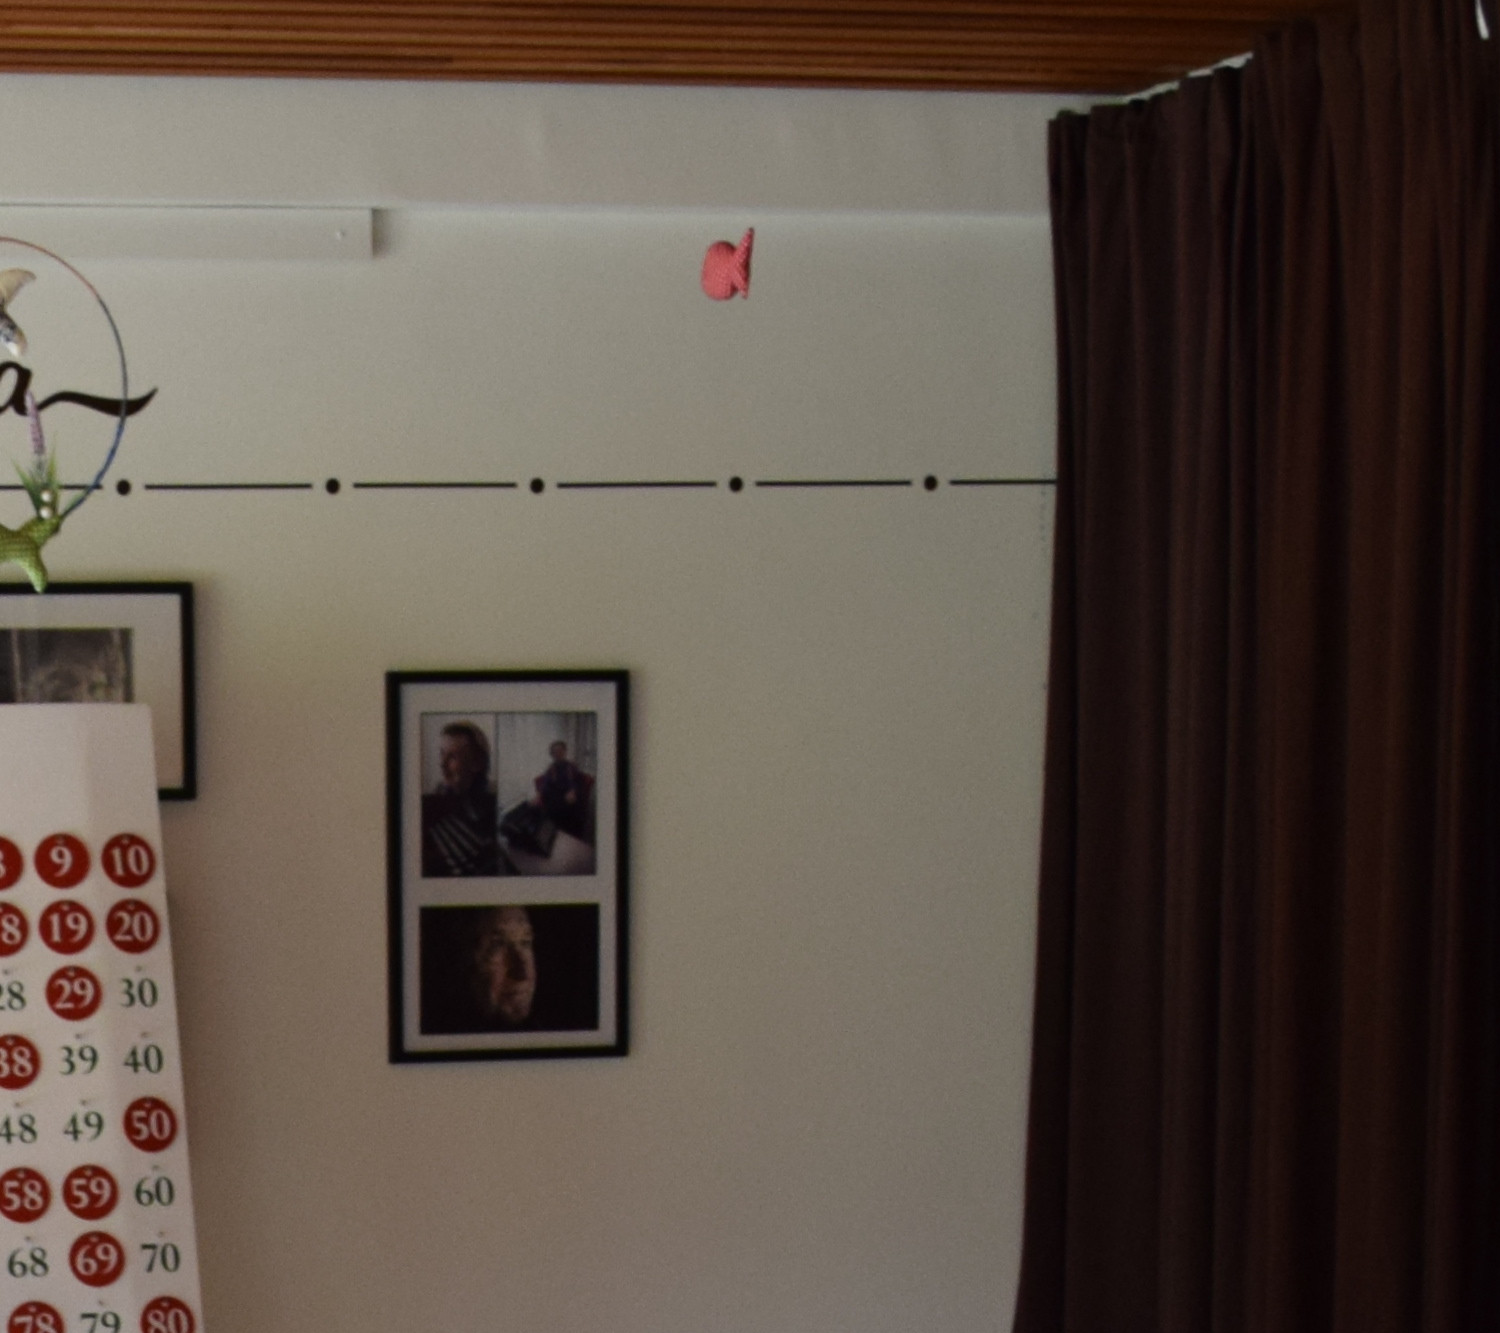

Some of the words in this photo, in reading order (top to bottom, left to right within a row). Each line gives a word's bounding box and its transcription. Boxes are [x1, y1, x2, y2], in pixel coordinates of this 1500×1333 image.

[50, 846, 73, 875] 9
[112, 846, 149, 875] 10
[50, 912, 88, 942] 19
[115, 911, 153, 941] 20
[55, 978, 95, 1009] 29
[120, 978, 158, 1007] 30
[60, 1045, 99, 1075] 39
[124, 1045, 163, 1073] 40
[63, 1112, 104, 1141] 49
[133, 1110, 170, 1140] 50
[4, 1180, 43, 1211] 58
[71, 1177, 111, 1208] 59
[134, 1177, 175, 1206] 60
[7, 1247, 49, 1278] 68
[75, 1243, 118, 1275] 69
[141, 1243, 181, 1273] 70
